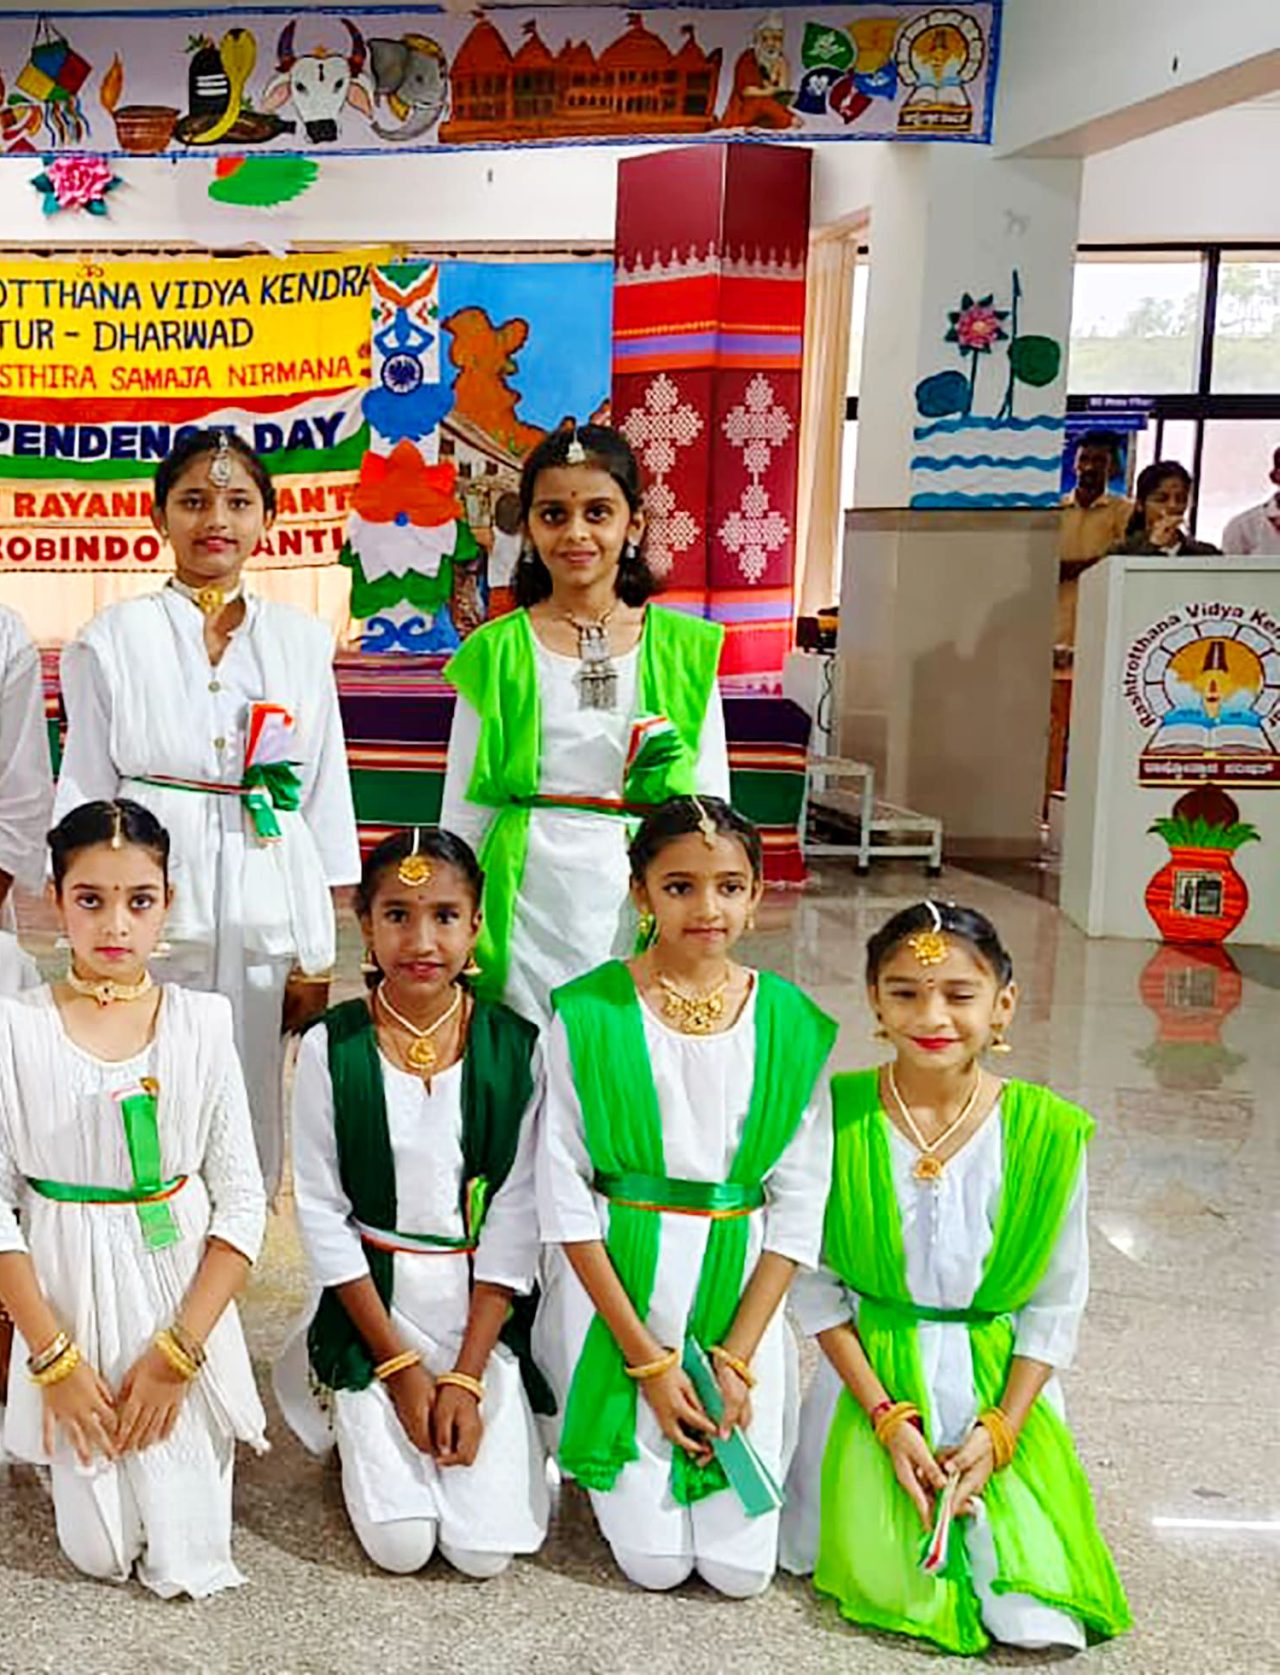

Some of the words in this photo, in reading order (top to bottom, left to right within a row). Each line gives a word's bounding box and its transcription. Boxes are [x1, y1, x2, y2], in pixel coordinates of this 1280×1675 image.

[150, 279, 250, 310] VIDYA
[93, 317, 253, 352] DHARWAD
[111, 366, 211, 391] SAMAJA
[228, 356, 352, 388] NIRMANA
[252, 411, 345, 454] DAY
[1186, 602, 1245, 620] Vidya
